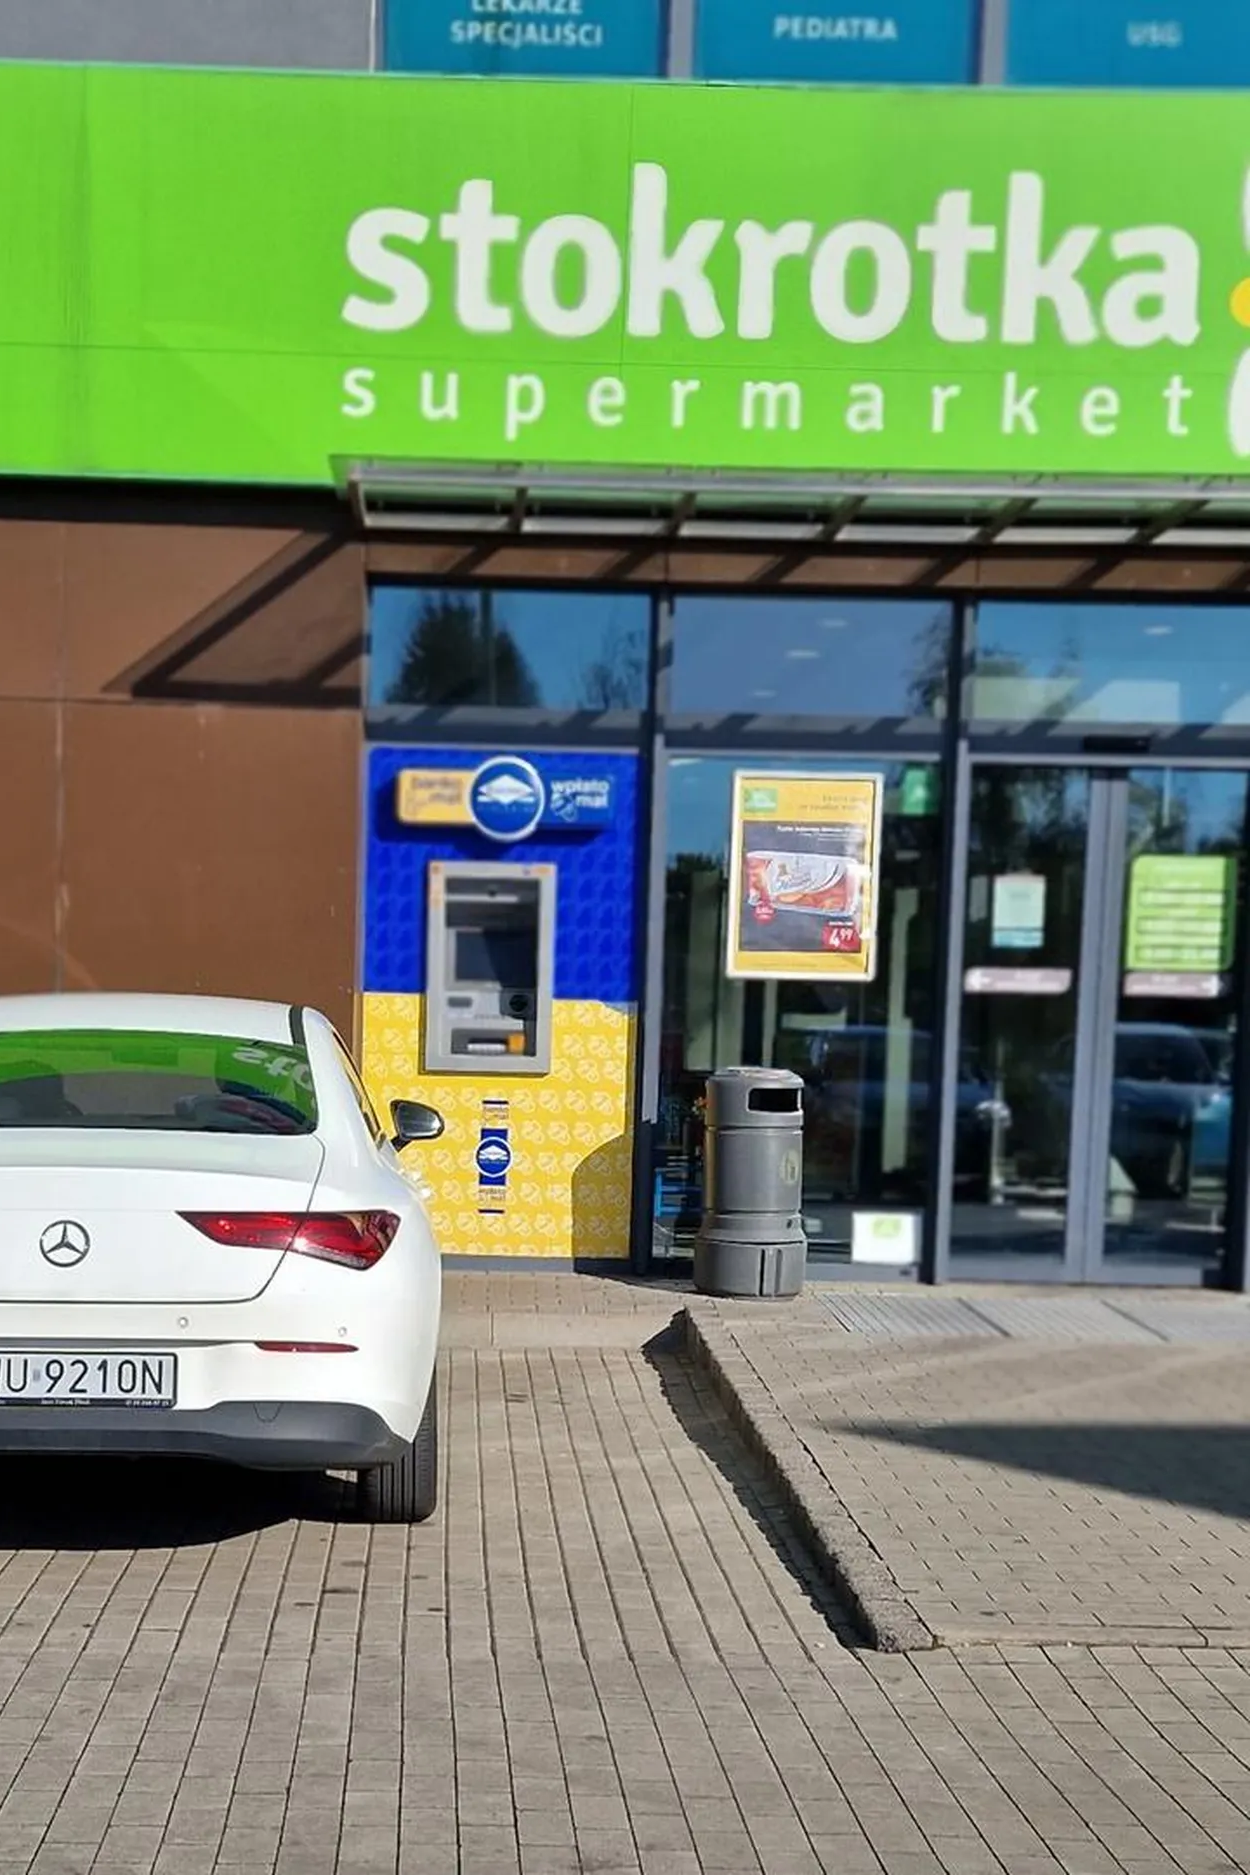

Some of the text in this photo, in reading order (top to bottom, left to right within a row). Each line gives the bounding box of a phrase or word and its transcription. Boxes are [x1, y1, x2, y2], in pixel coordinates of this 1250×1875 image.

[450, 20, 603, 48] SPECJALIŚCI
[774, 16, 897, 40] PEDIATRA
[341, 162, 1202, 347] stokrotka
[341, 367, 1193, 441] supermarket
[45, 1359, 164, 1395] 9210N
